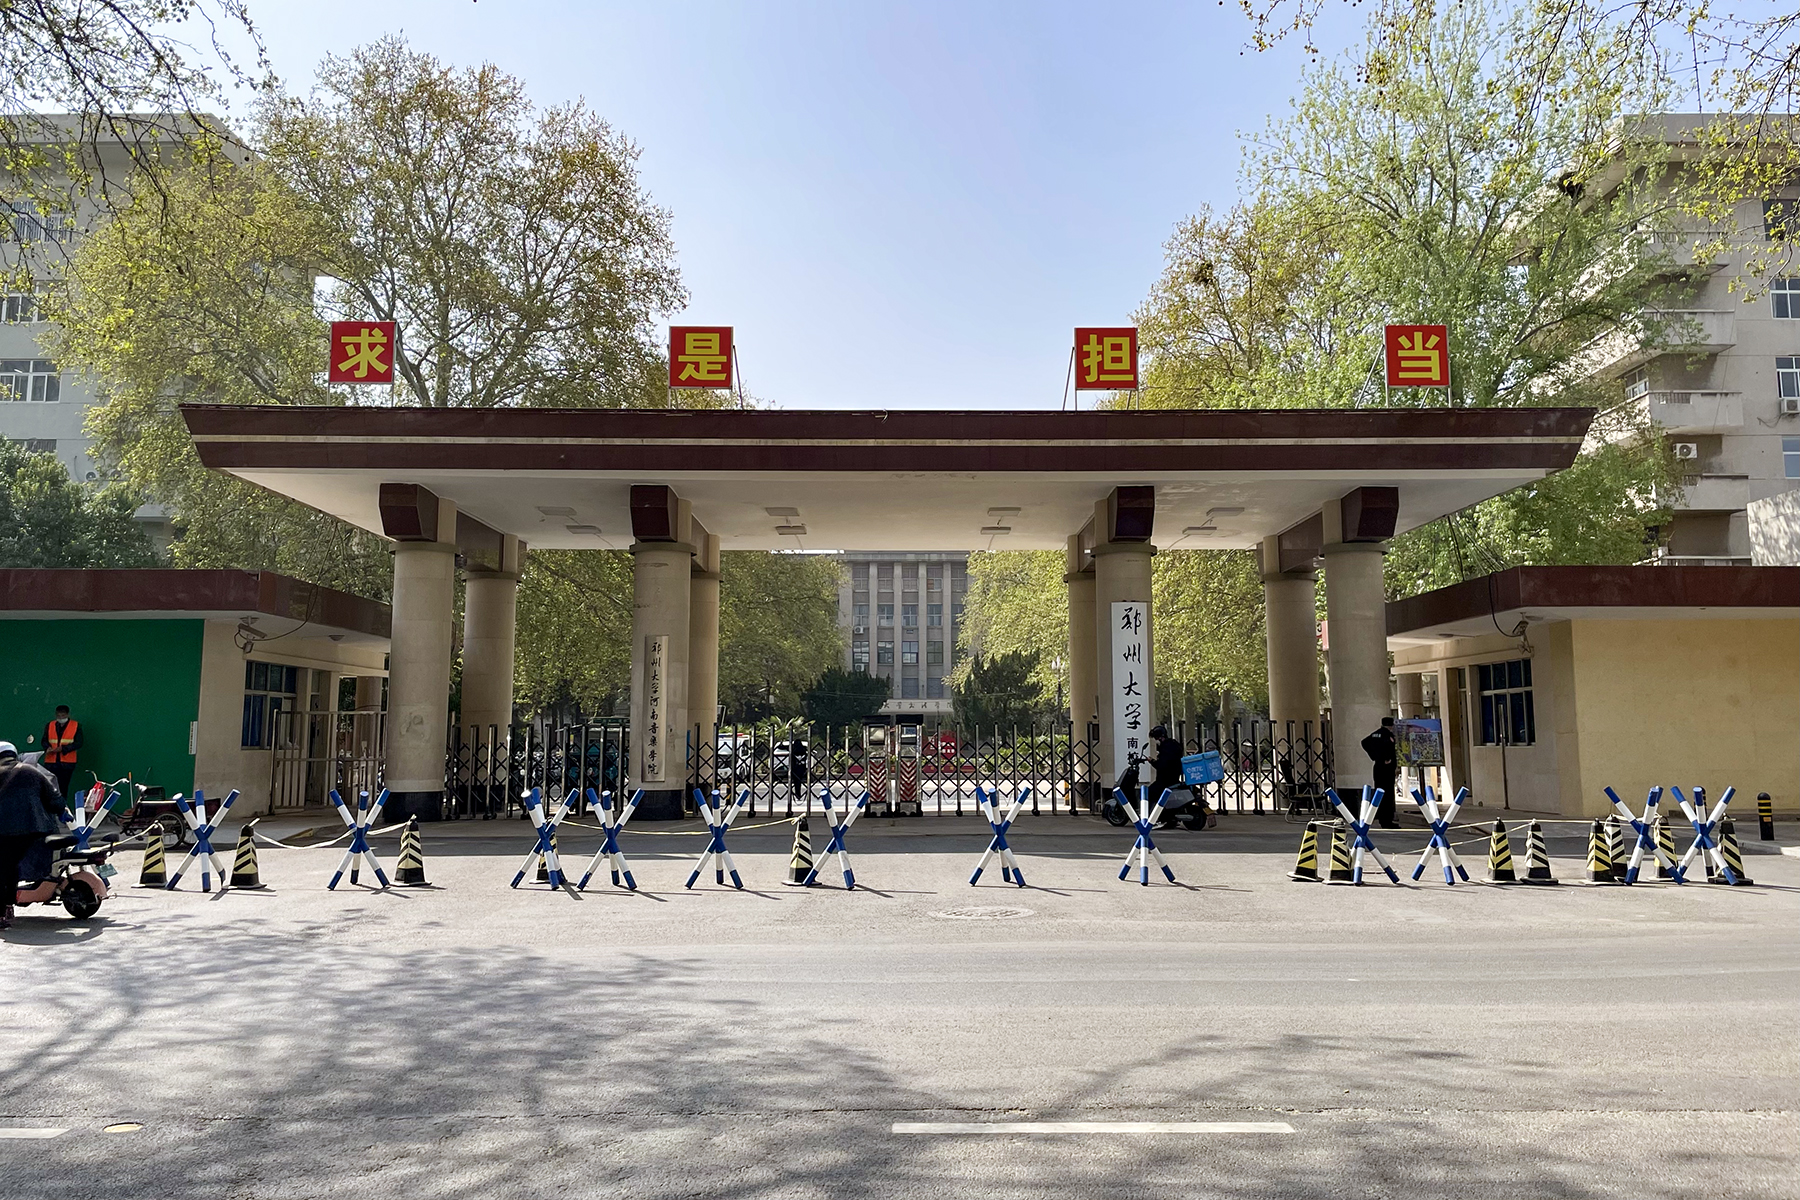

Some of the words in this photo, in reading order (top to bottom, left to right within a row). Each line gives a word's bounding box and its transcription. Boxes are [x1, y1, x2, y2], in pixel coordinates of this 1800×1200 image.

[337, 327, 390, 379] 求
[678, 332, 728, 381] 是
[1082, 333, 1135, 383] 担
[1397, 331, 1440, 381] 当
